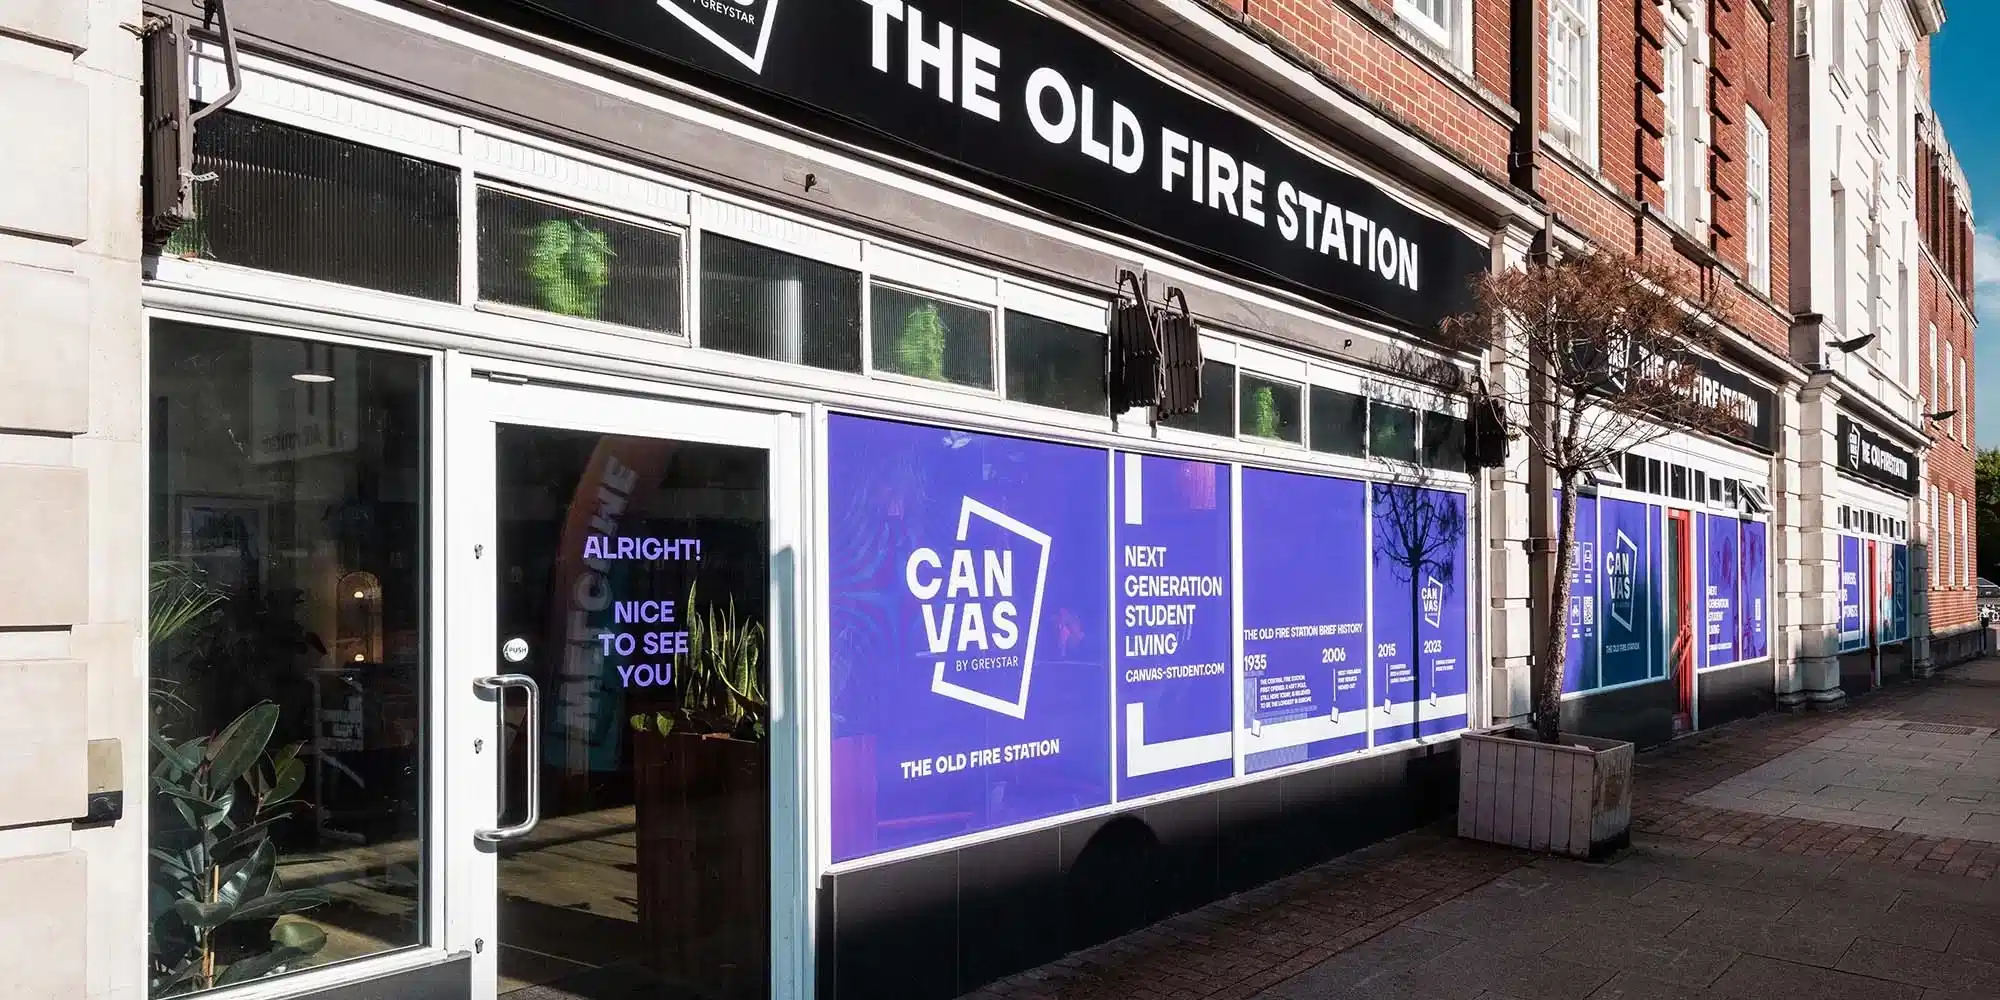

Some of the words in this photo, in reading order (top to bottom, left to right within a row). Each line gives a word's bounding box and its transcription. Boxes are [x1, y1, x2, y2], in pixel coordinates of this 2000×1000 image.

[701, 0, 755, 25] GREYSTAR
[860, 0, 1001, 122] THE
[1025, 67, 1145, 175] OLD
[1161, 126, 1266, 227] FIRE
[1276, 181, 1420, 291] STATION
[583, 536, 702, 561] ALRIGHT!
[1125, 546, 1166, 568] NEXT
[906, 547, 1013, 600] CAN
[1606, 552, 1629, 575] CAN
[1125, 575, 1223, 597] GENERATION
[1422, 588, 1438, 599] CAN
[1610, 577, 1631, 600] VAS
[614, 600, 675, 623] NICE
[1125, 604, 1196, 627] STUDENT
[1423, 600, 1439, 612] VAS
[921, 601, 1020, 653] VAS
[1243, 629, 1258, 641] THE
[1259, 628, 1274, 640] OLD
[1275, 627, 1290, 639] FIRE
[1290, 625, 1319, 638] STATION
[1319, 624, 1337, 636] BRIEF
[1337, 623, 1363, 635] HISTORY
[598, 633, 636, 657] TO
[643, 631, 689, 654] SEE
[1125, 633, 1178, 656] LIVING
[1322, 647, 1347, 663] 2006
[1378, 643, 1396, 658] 2015
[1423, 640, 1442, 653] 2023
[956, 657, 969, 671] BY
[971, 655, 1019, 671] GREYSTAR
[1125, 663, 1225, 683] CANVAS-STUDENT.COM
[1243, 654, 1267, 672] 1935
[617, 663, 672, 688] YOU
[901, 758, 932, 780] THE
[936, 754, 967, 774] OLD
[970, 748, 1001, 768] FIRE
[1004, 739, 1060, 764] STATION
